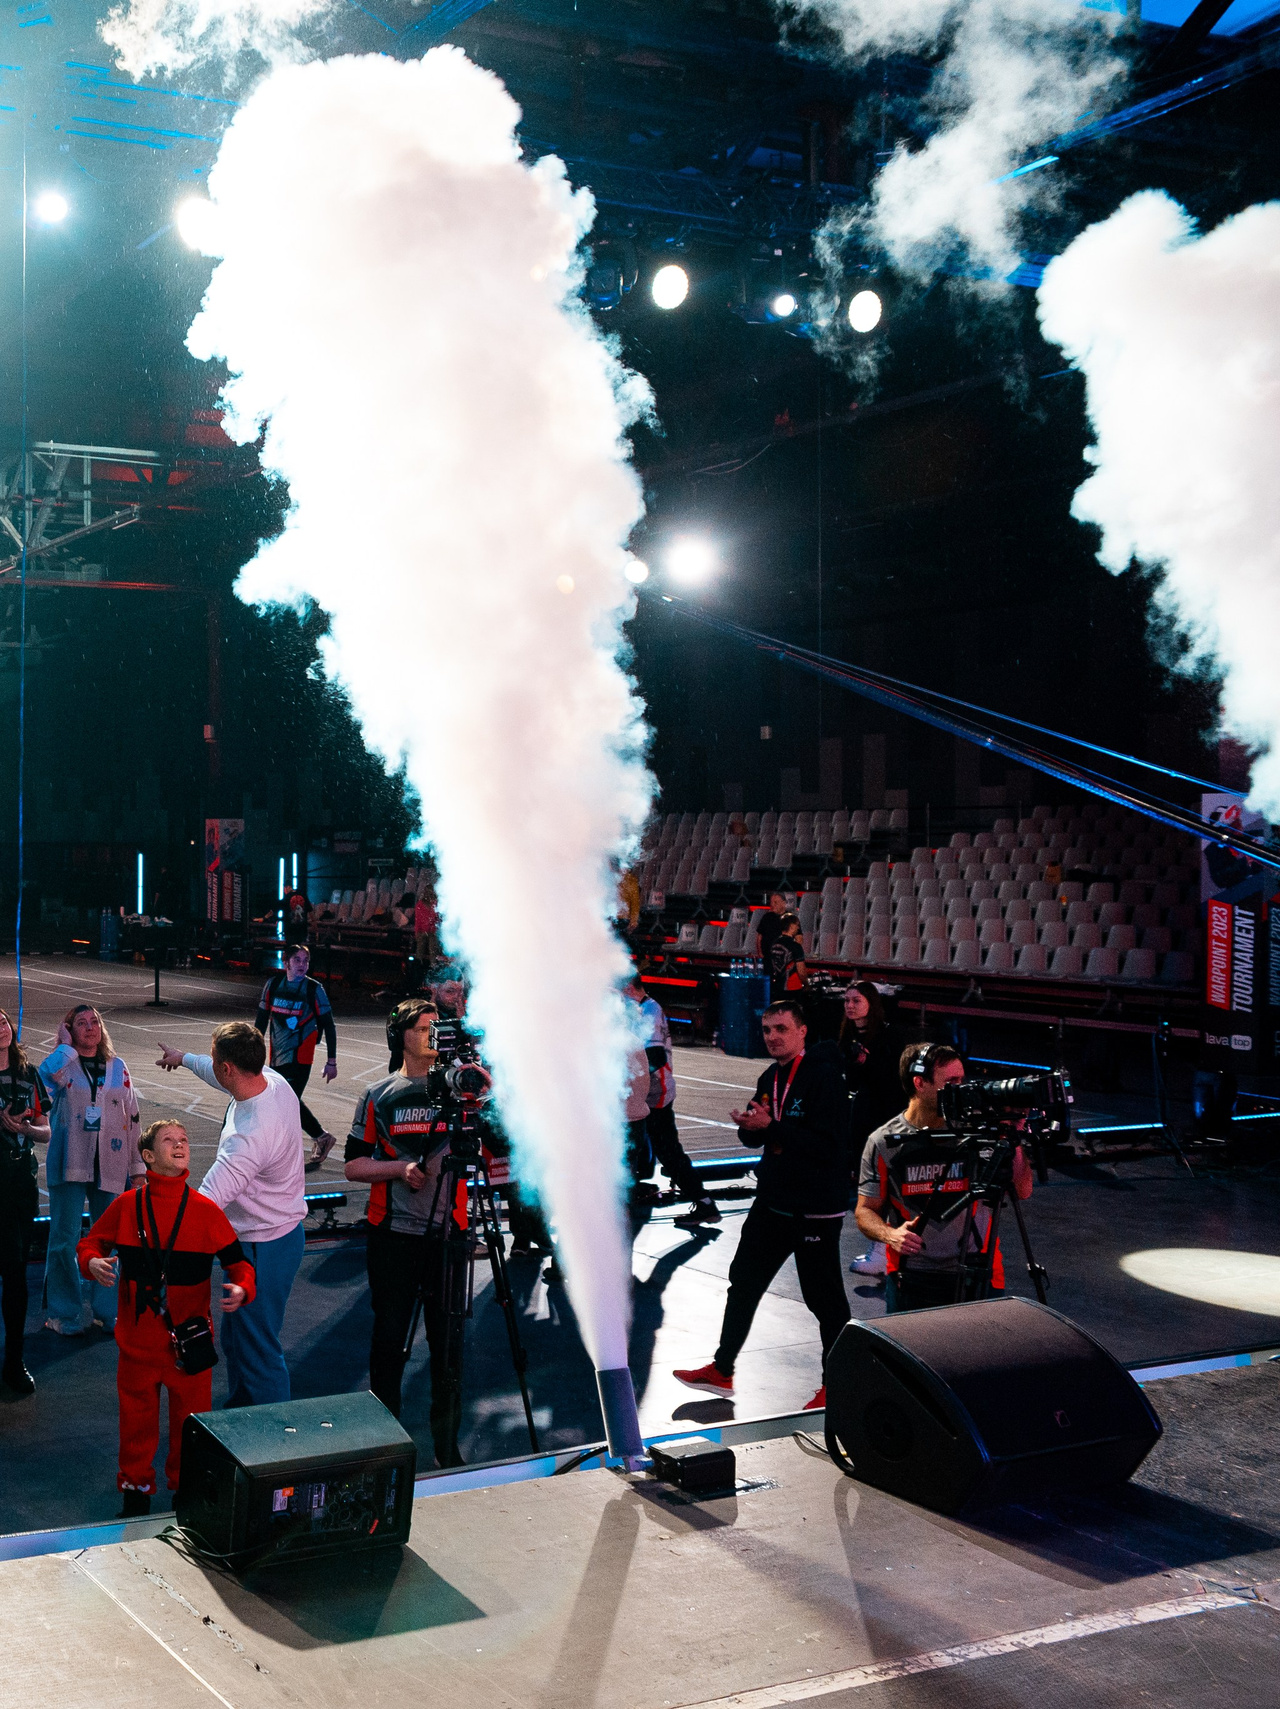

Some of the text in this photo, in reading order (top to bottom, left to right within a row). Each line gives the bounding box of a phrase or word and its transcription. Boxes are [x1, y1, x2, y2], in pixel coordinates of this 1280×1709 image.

[233, 872, 242, 922] TOURNAMENT
[1210, 905, 1228, 1004] WARPOINT 2023
[1232, 905, 1255, 1013] TOURNAMENT
[1205, 1032, 1230, 1047] lava
[393, 1123, 431, 1133] TOURNAMENT
